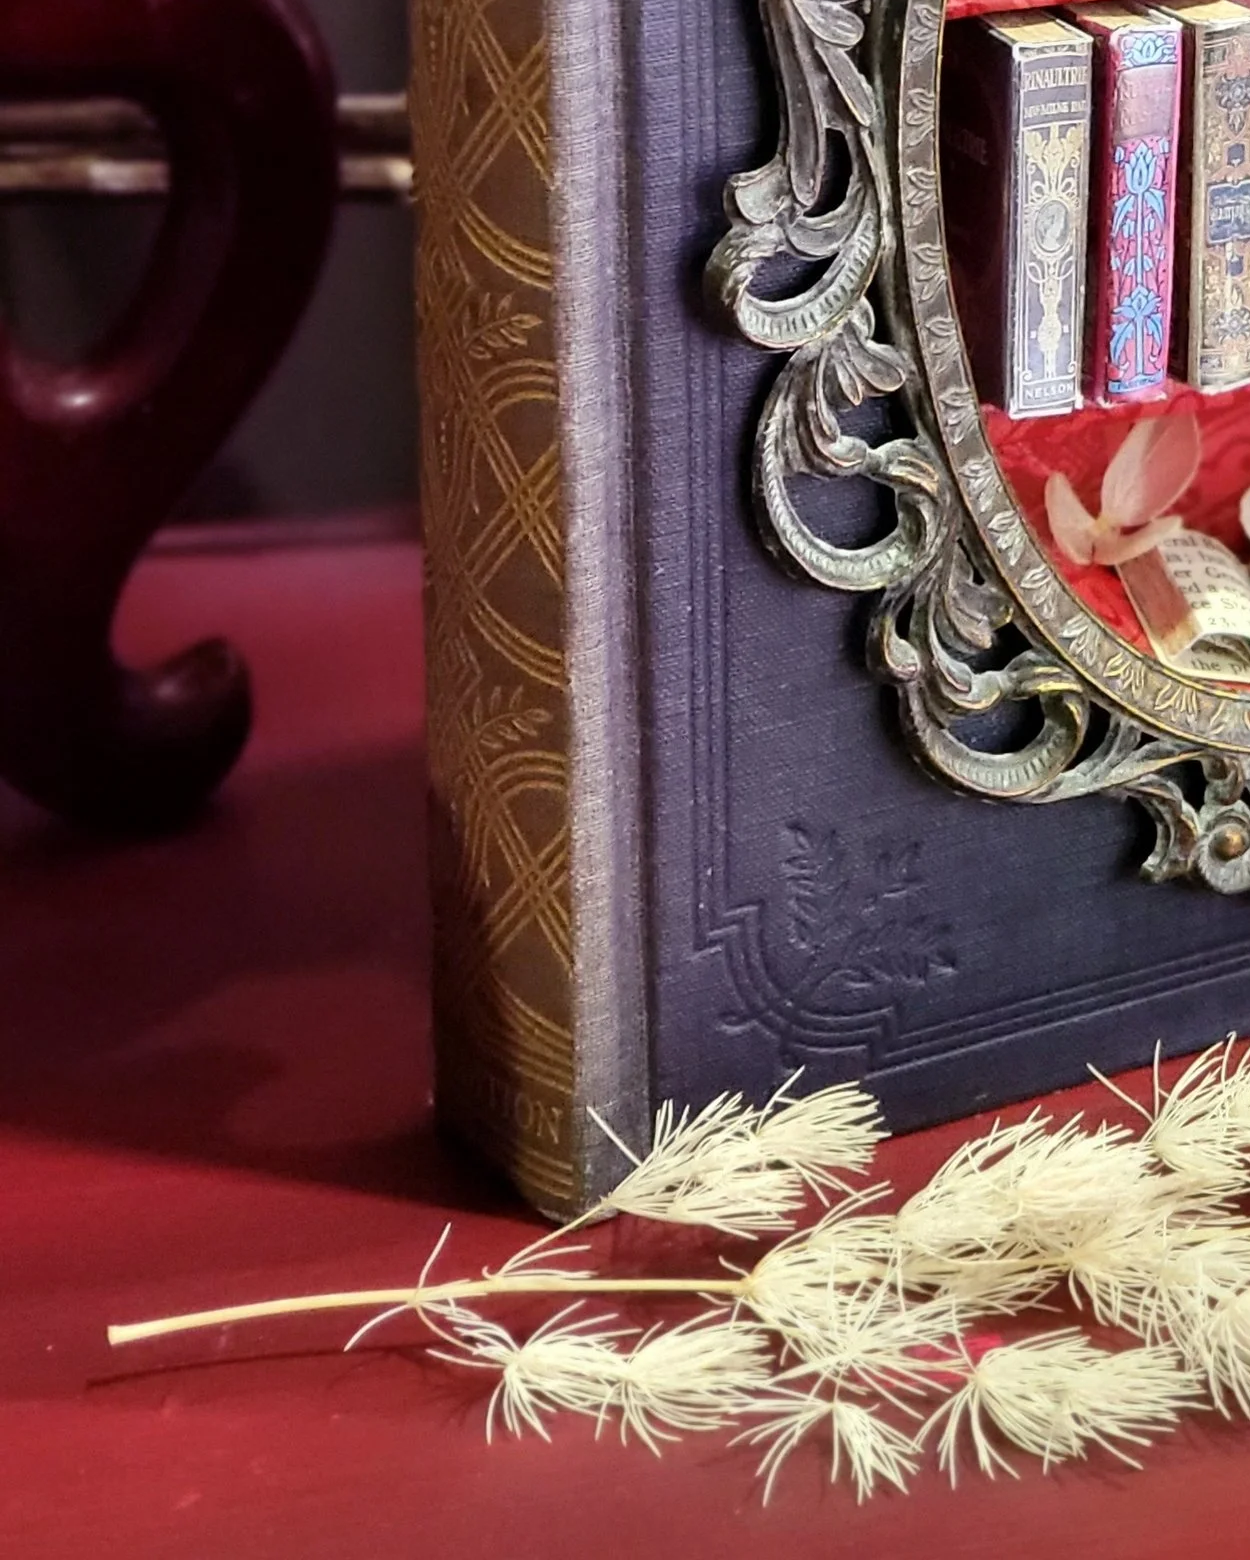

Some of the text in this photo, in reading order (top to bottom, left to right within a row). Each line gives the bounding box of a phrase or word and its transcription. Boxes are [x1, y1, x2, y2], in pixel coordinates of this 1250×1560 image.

[1025, 383, 1074, 400] NELSON
[1191, 600, 1212, 610] ce
[1190, 656, 1222, 672] the
